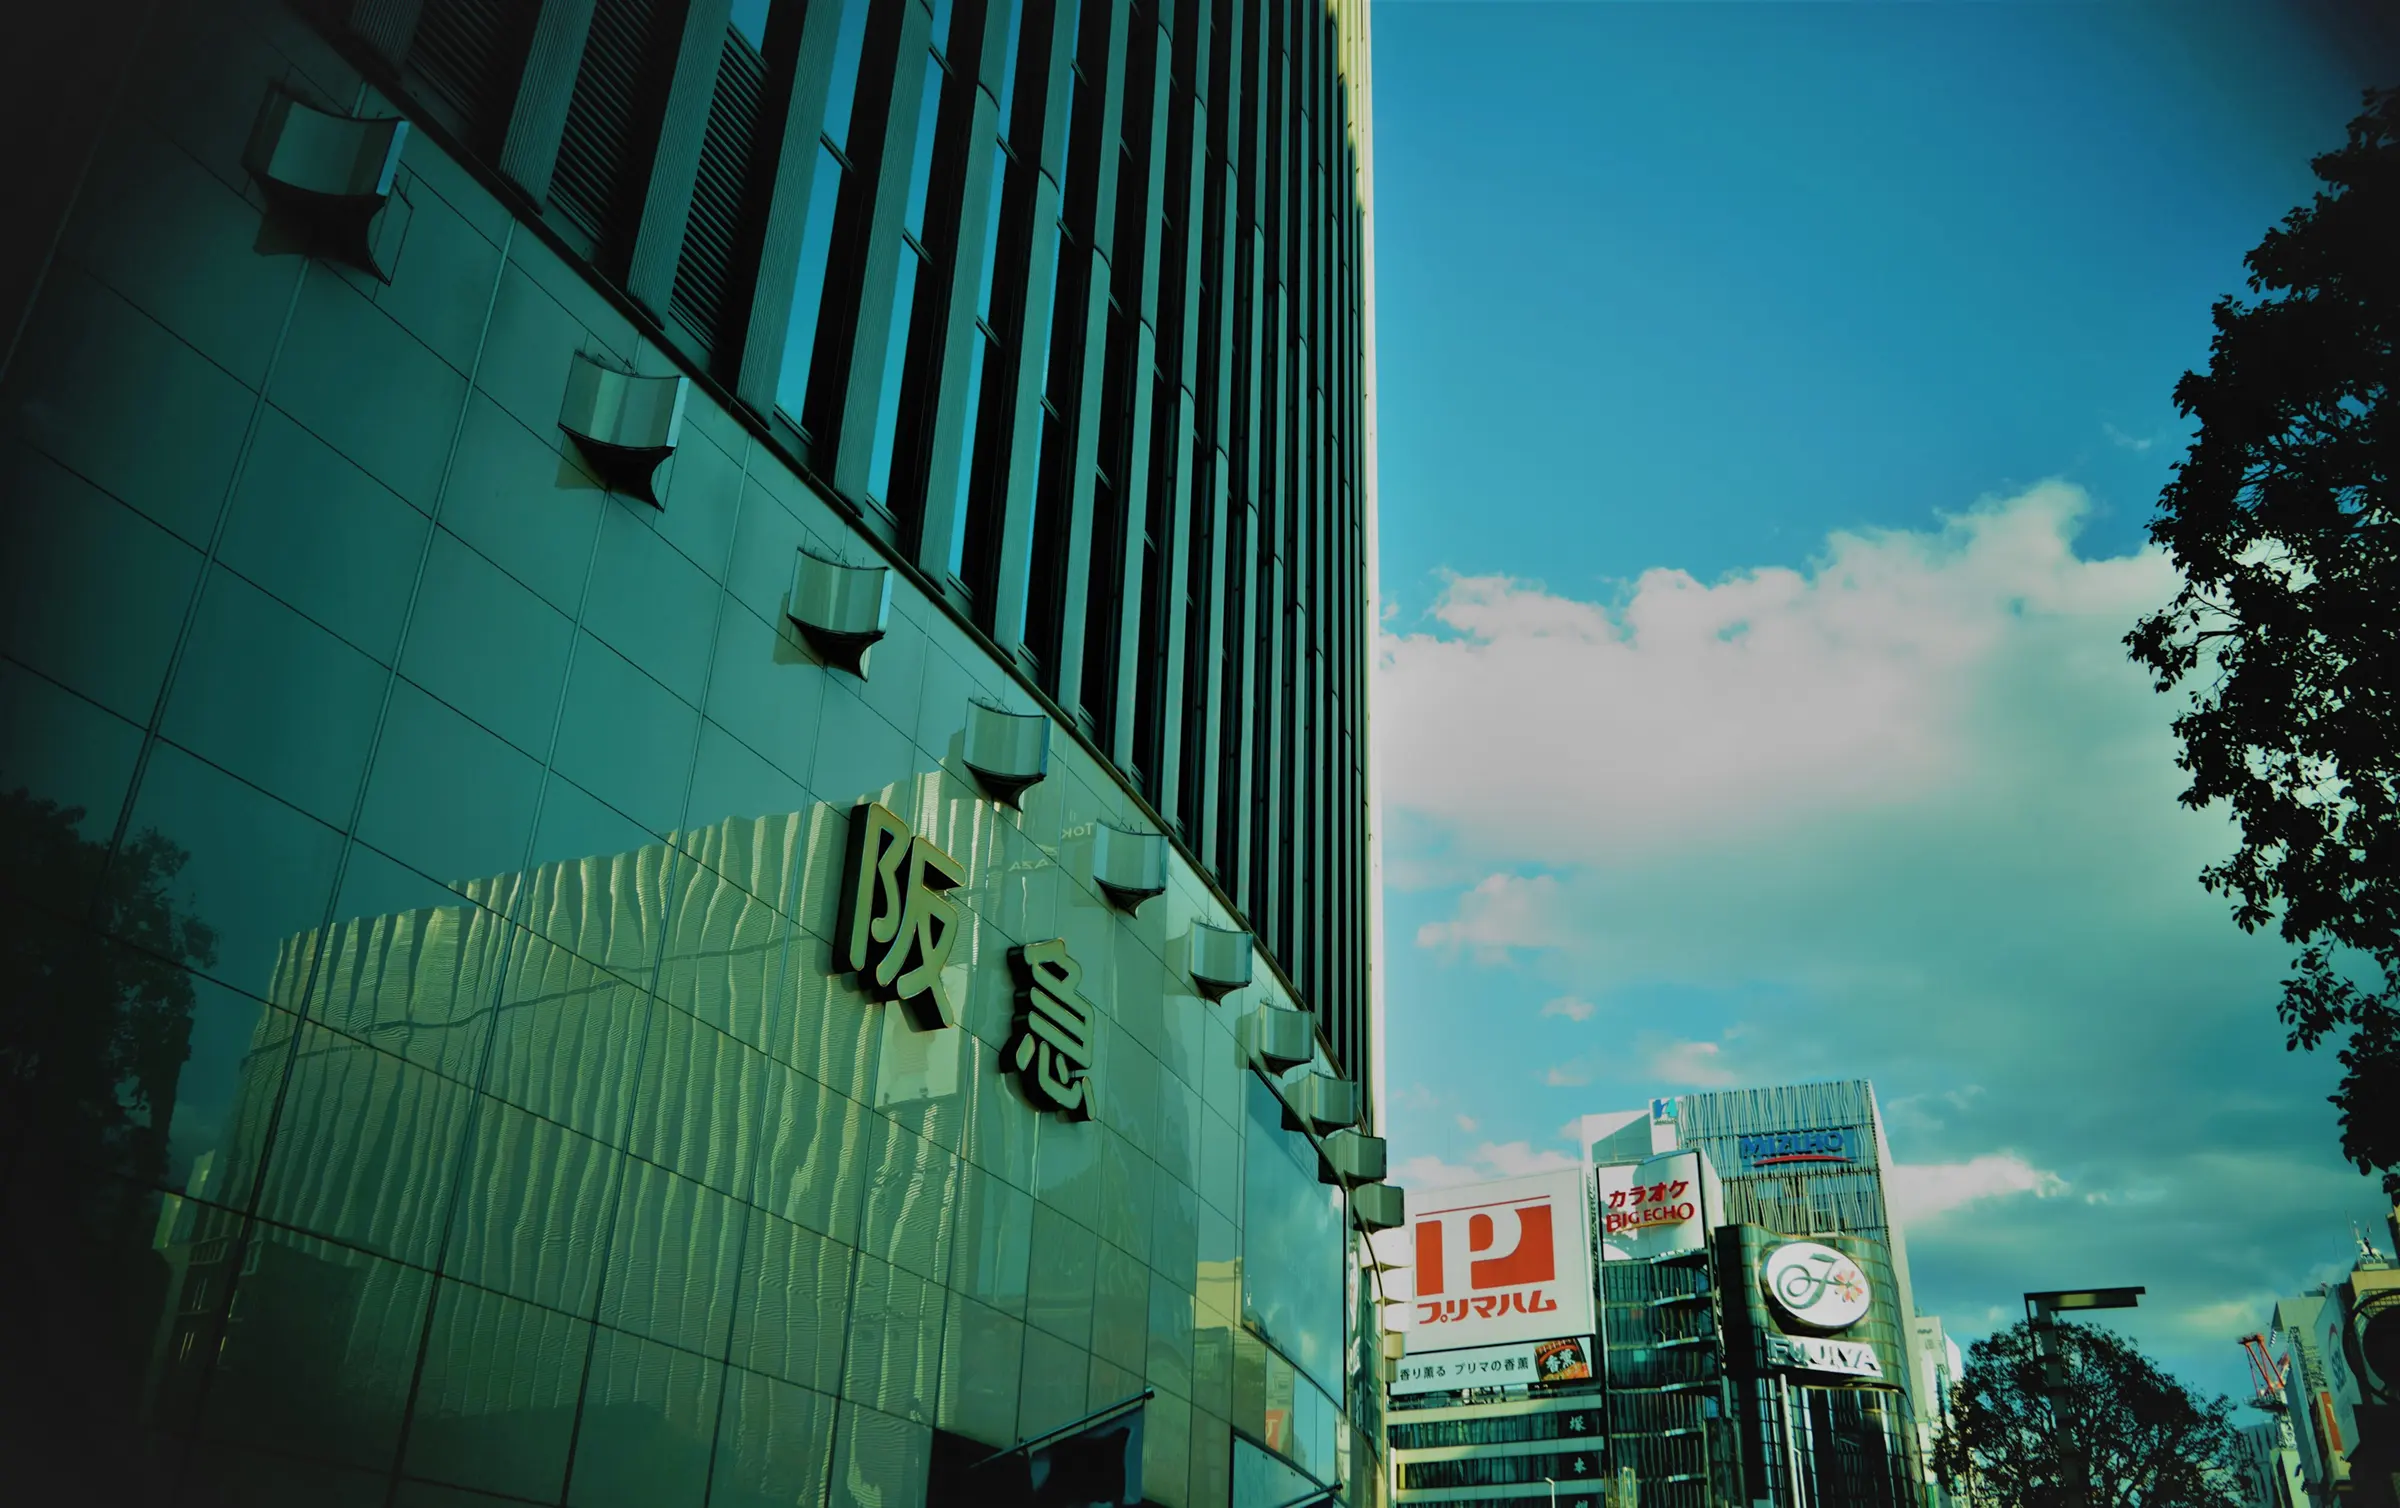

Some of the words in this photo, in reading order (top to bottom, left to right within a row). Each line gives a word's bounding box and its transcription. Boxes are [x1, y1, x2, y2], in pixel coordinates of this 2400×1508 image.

[842, 801, 1097, 1122] 阪急
[1740, 1130, 1844, 1157] MIZUHO
[1607, 1179, 1689, 1209] カラオケ
[1605, 1211, 1640, 1233] BIG
[1643, 1202, 1695, 1222] ECHO
[1416, 1289, 1558, 1325] プリマハム
[1399, 1365, 1446, 1381] 香り薫る
[1454, 1356, 1530, 1376] プリマの香薫
[1769, 1336, 1880, 1373] FUJIYA
